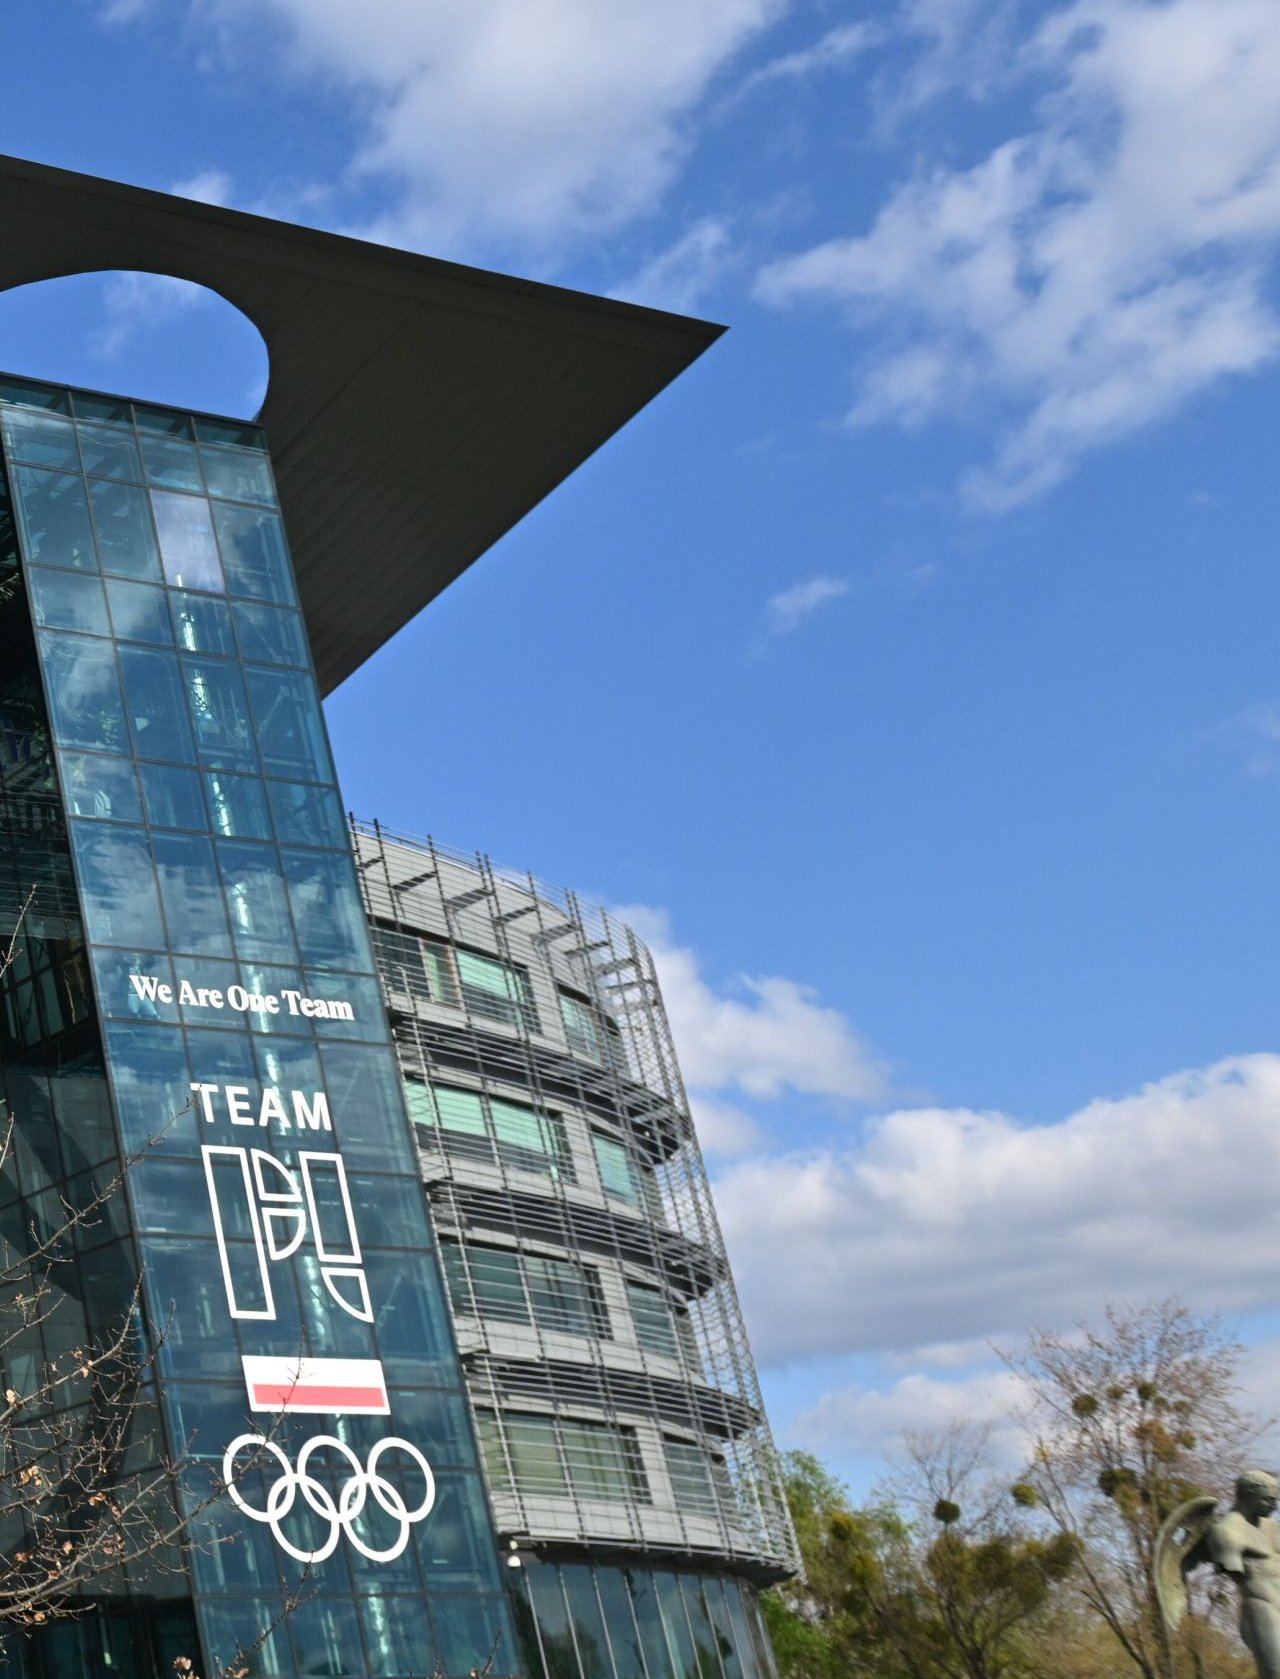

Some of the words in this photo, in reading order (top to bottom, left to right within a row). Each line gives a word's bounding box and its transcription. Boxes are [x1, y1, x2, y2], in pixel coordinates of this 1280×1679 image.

[129, 974, 173, 1004] We
[178, 980, 224, 1009] Are
[227, 985, 280, 1014] One
[281, 990, 355, 1021] Team
[190, 1082, 333, 1131] TEAM
